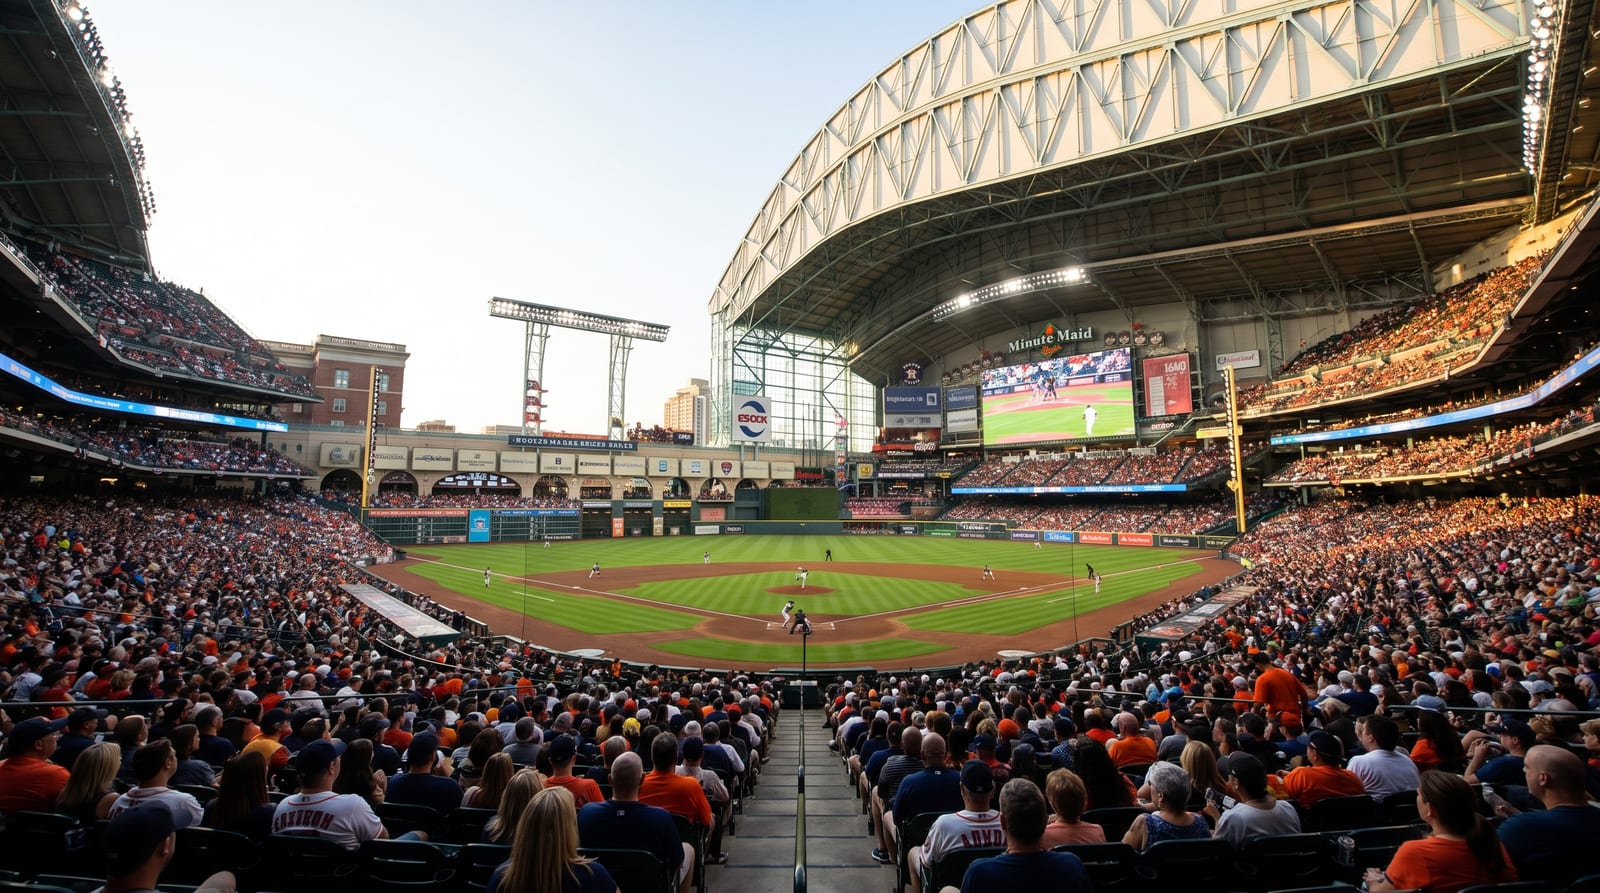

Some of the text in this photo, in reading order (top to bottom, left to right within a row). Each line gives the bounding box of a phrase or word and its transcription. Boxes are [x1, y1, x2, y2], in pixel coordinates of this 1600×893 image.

[1007, 334, 1055, 354] Minute
[1057, 326, 1093, 342] Maid
[737, 413, 768, 424] ESOCK
